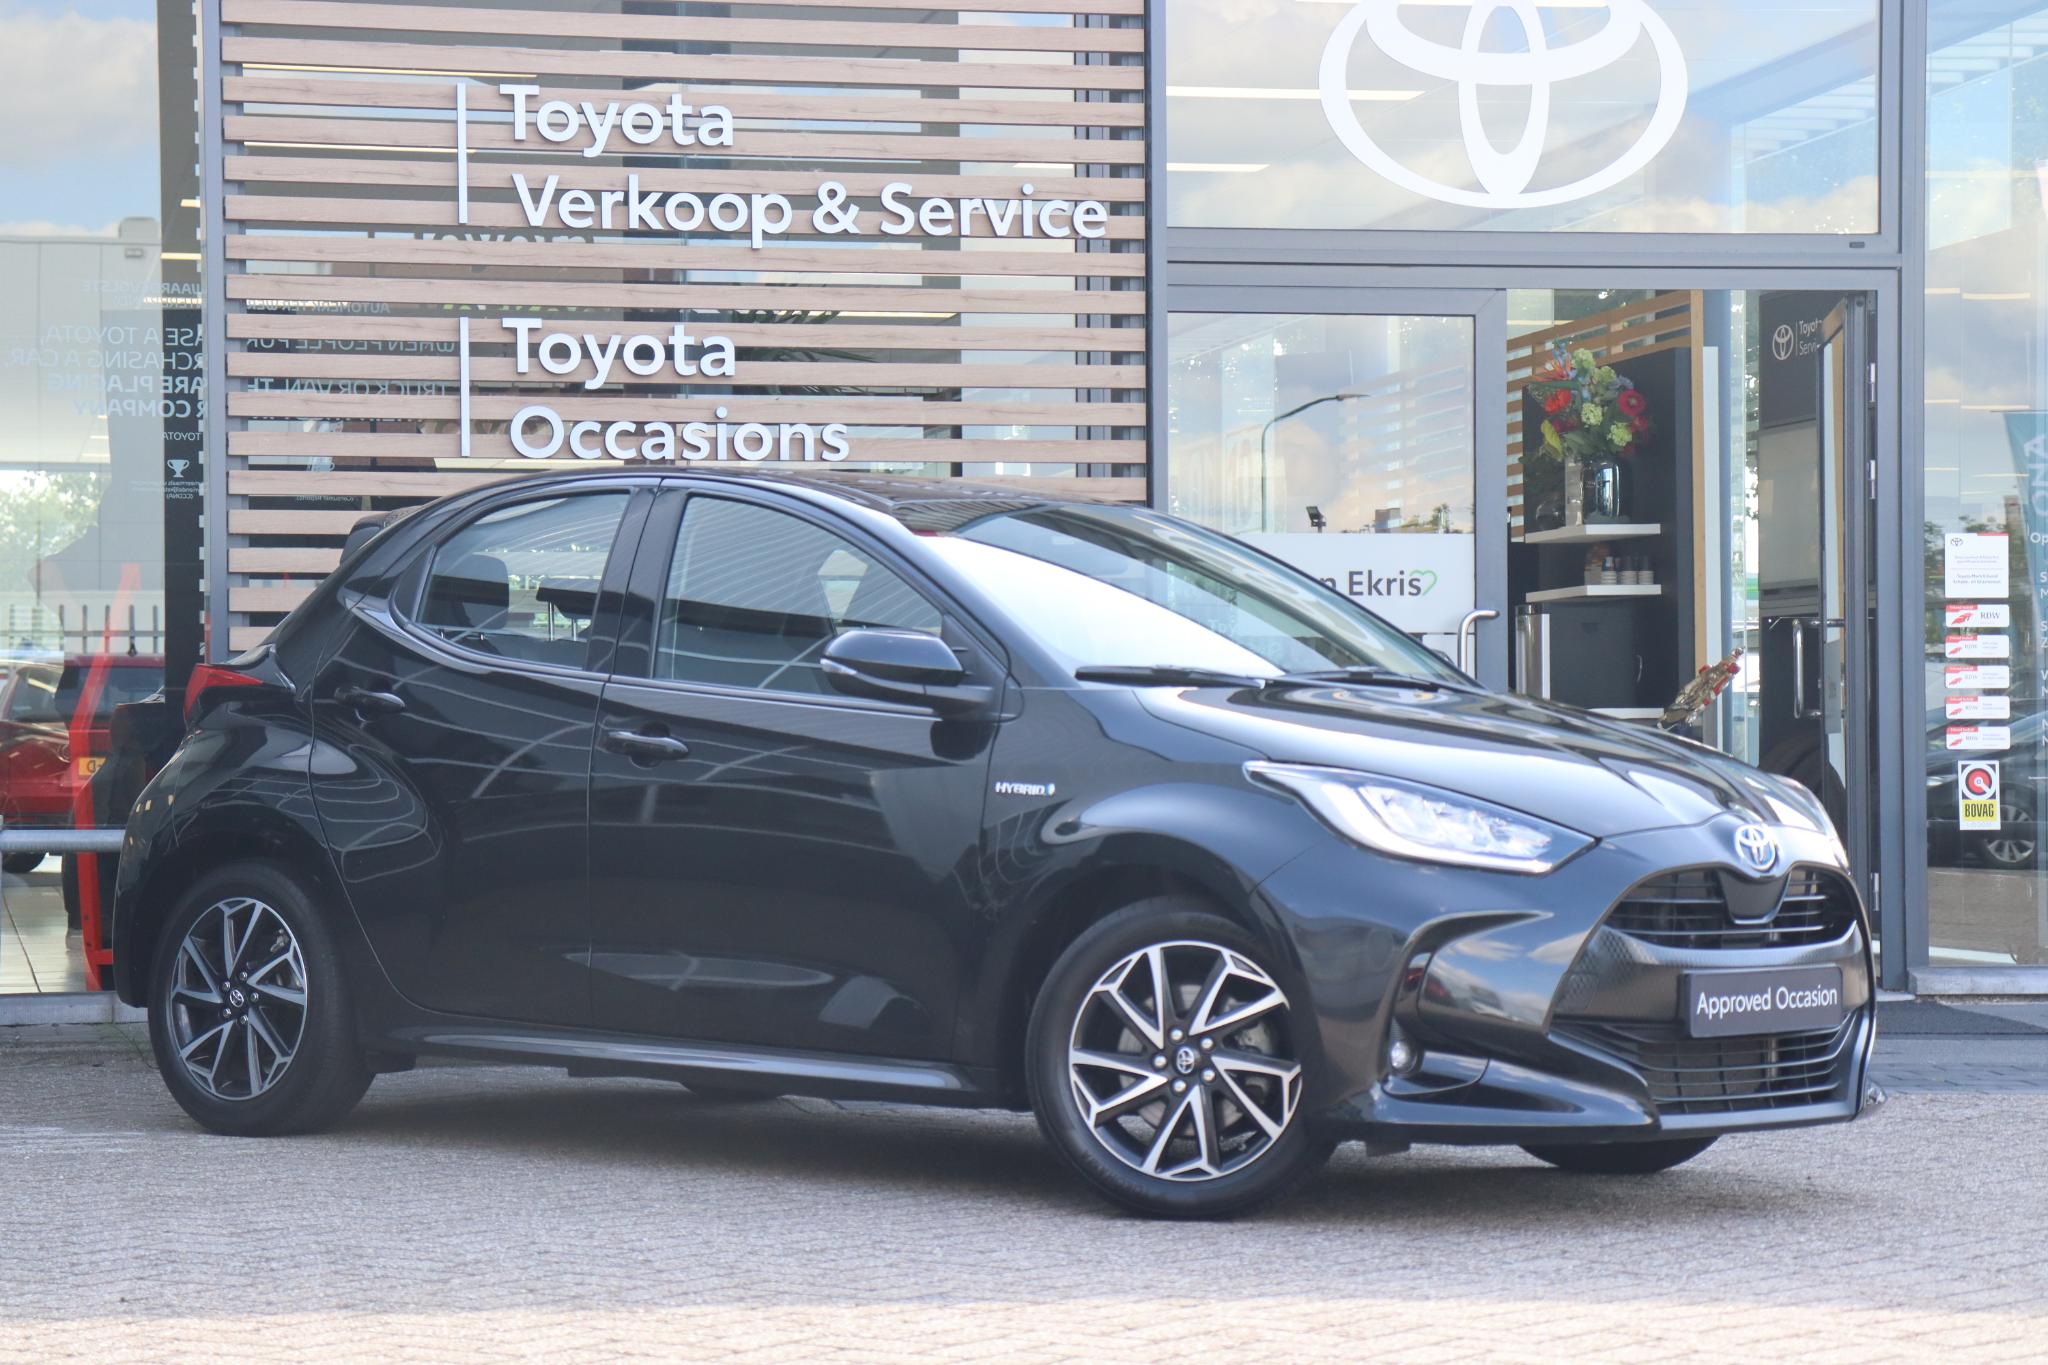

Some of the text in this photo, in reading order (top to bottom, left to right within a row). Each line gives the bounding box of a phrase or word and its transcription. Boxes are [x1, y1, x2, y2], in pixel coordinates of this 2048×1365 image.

[499, 84, 734, 158] Toyota
[511, 173, 1109, 249] Verkoop & Service
[501, 317, 736, 390] Toyota
[509, 405, 851, 462] Occasions
[1348, 569, 1422, 597] Ekris
[995, 782, 1046, 796] HYBRID
[1964, 803, 1994, 818] BOVAG
[1696, 984, 1838, 1020] Approved Occasion
